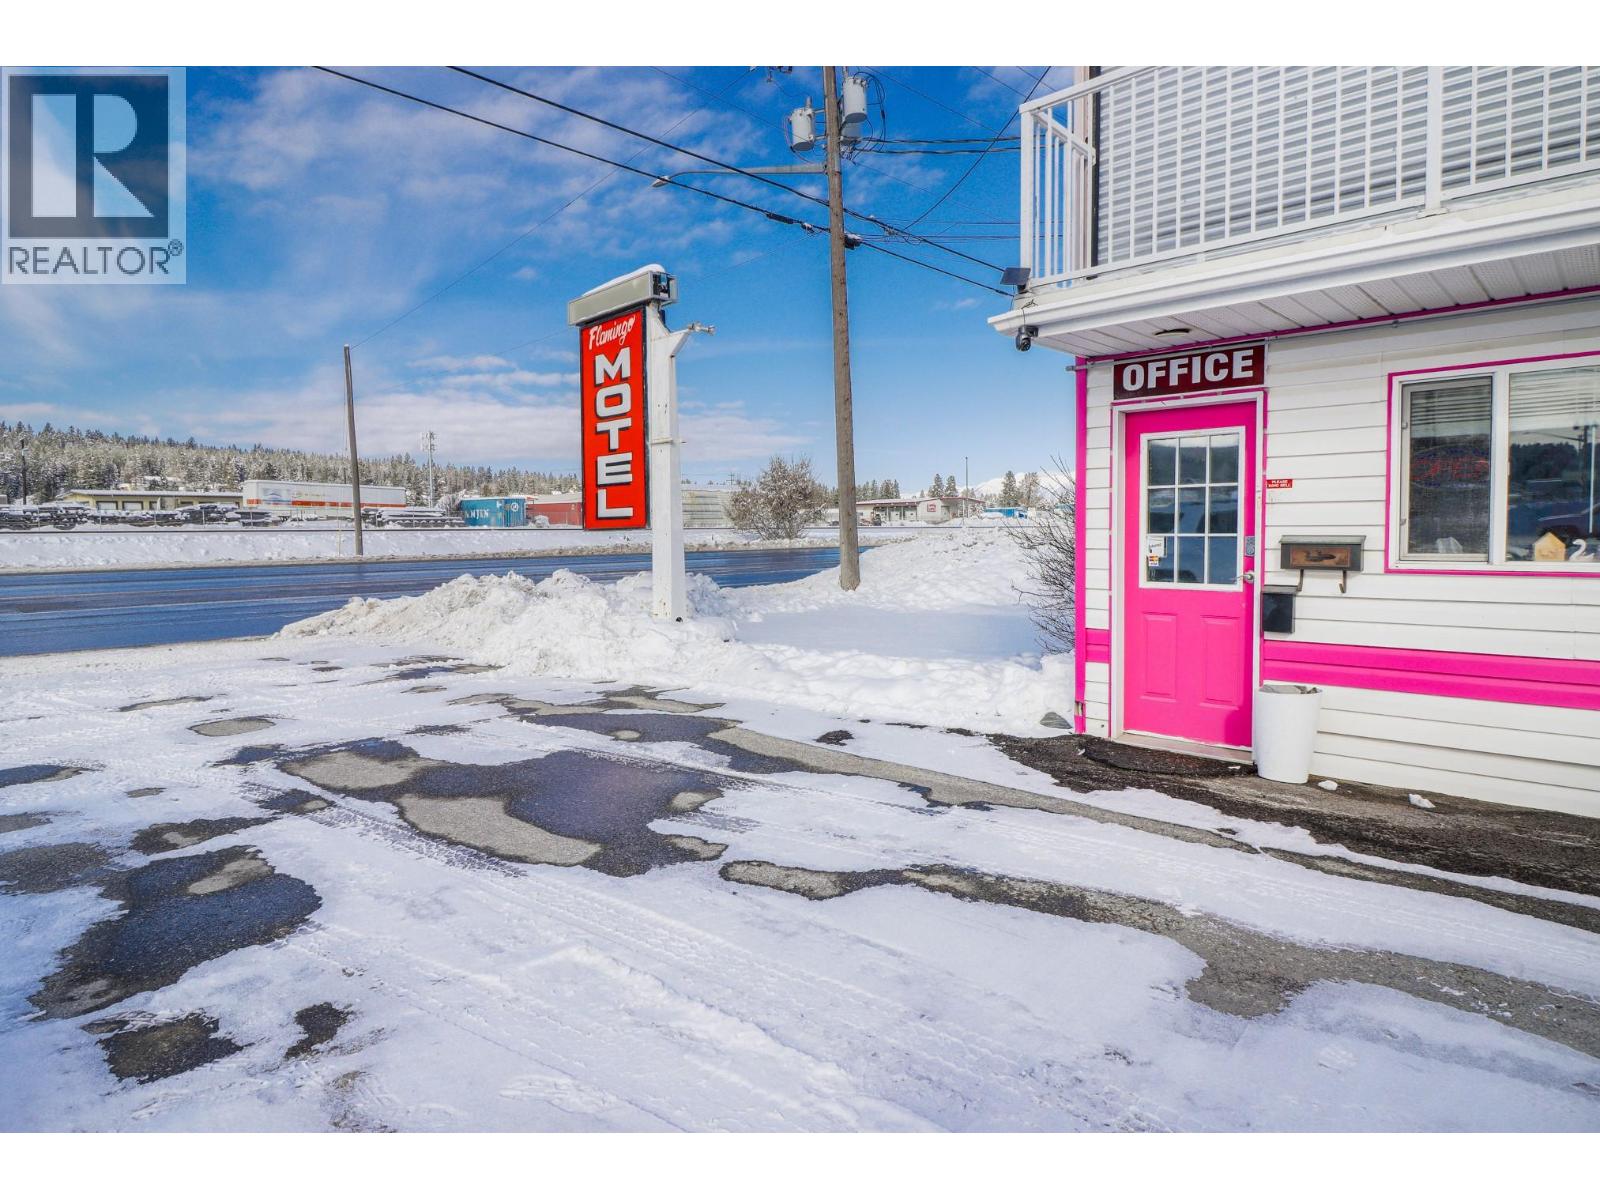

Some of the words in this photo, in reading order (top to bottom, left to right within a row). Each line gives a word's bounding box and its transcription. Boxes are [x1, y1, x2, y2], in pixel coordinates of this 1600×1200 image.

[588, 315, 636, 350] Flamingo
[1122, 349, 1254, 392] OFFICE
[594, 347, 633, 518] MOTEL
